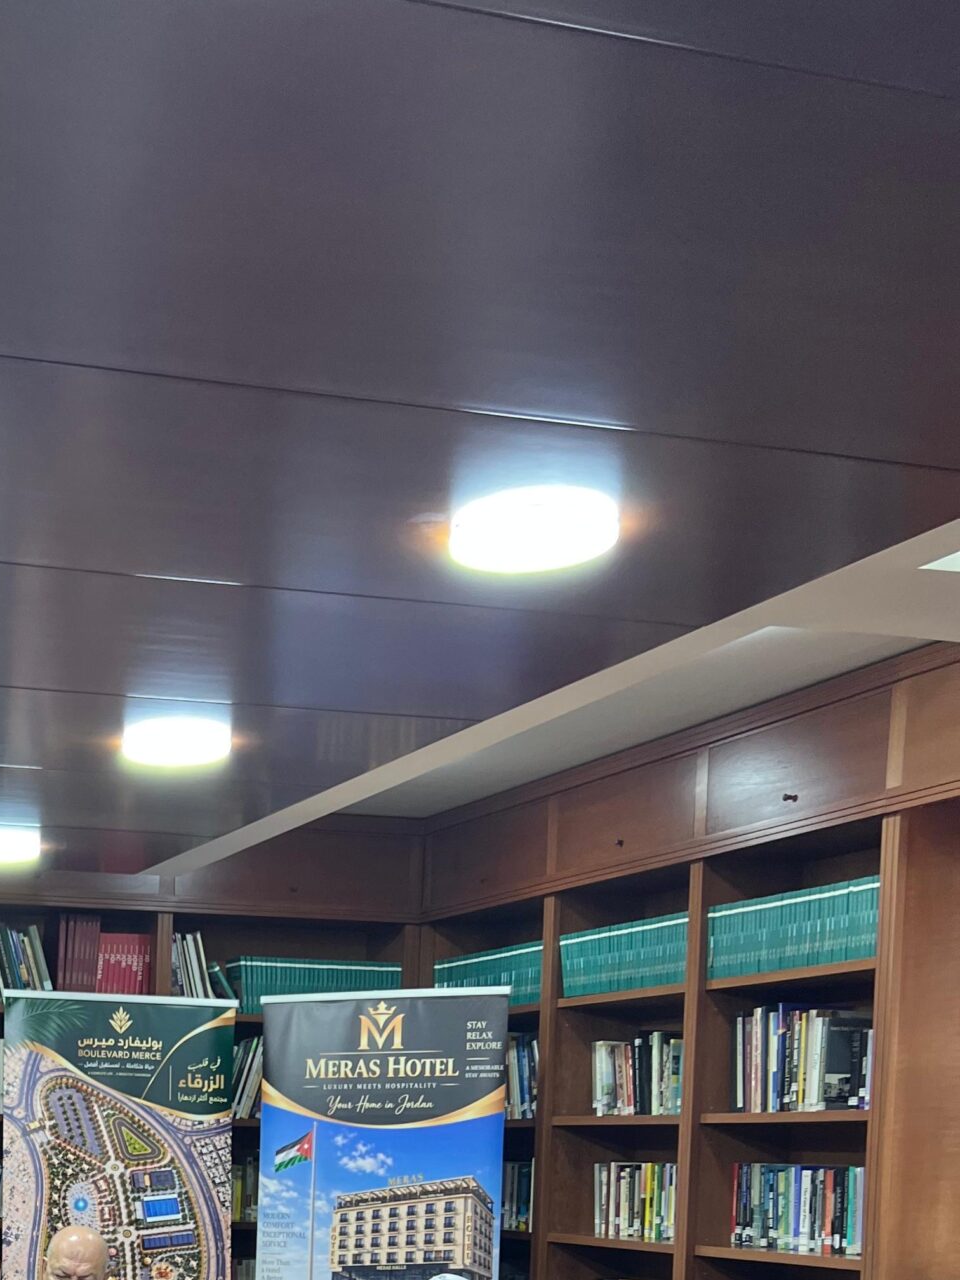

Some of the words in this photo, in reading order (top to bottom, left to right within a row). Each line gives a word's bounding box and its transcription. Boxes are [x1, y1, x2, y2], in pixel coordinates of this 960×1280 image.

[466, 1020, 487, 1029] STAY
[77, 1036, 116, 1048] ميرس
[466, 1031, 493, 1040] RELAX
[117, 1035, 163, 1051] بوليفارد
[466, 1041, 503, 1050] EXPLORE
[77, 1048, 130, 1059] BOULEVARD
[131, 1050, 162, 1060] MERCE
[187, 1057, 209, 1072] قلب
[209, 1055, 221, 1072] في
[304, 1057, 381, 1079] MERAS
[386, 1055, 460, 1078] HOTEL
[178, 1072, 224, 1092] الزرقاء
[326, 1095, 353, 1115] Your
[355, 1094, 383, 1113] Home
[384, 1099, 395, 1109] in
[394, 1094, 434, 1115] Jordan
[262, 1231, 306, 1239] EXCEPTIONAL
